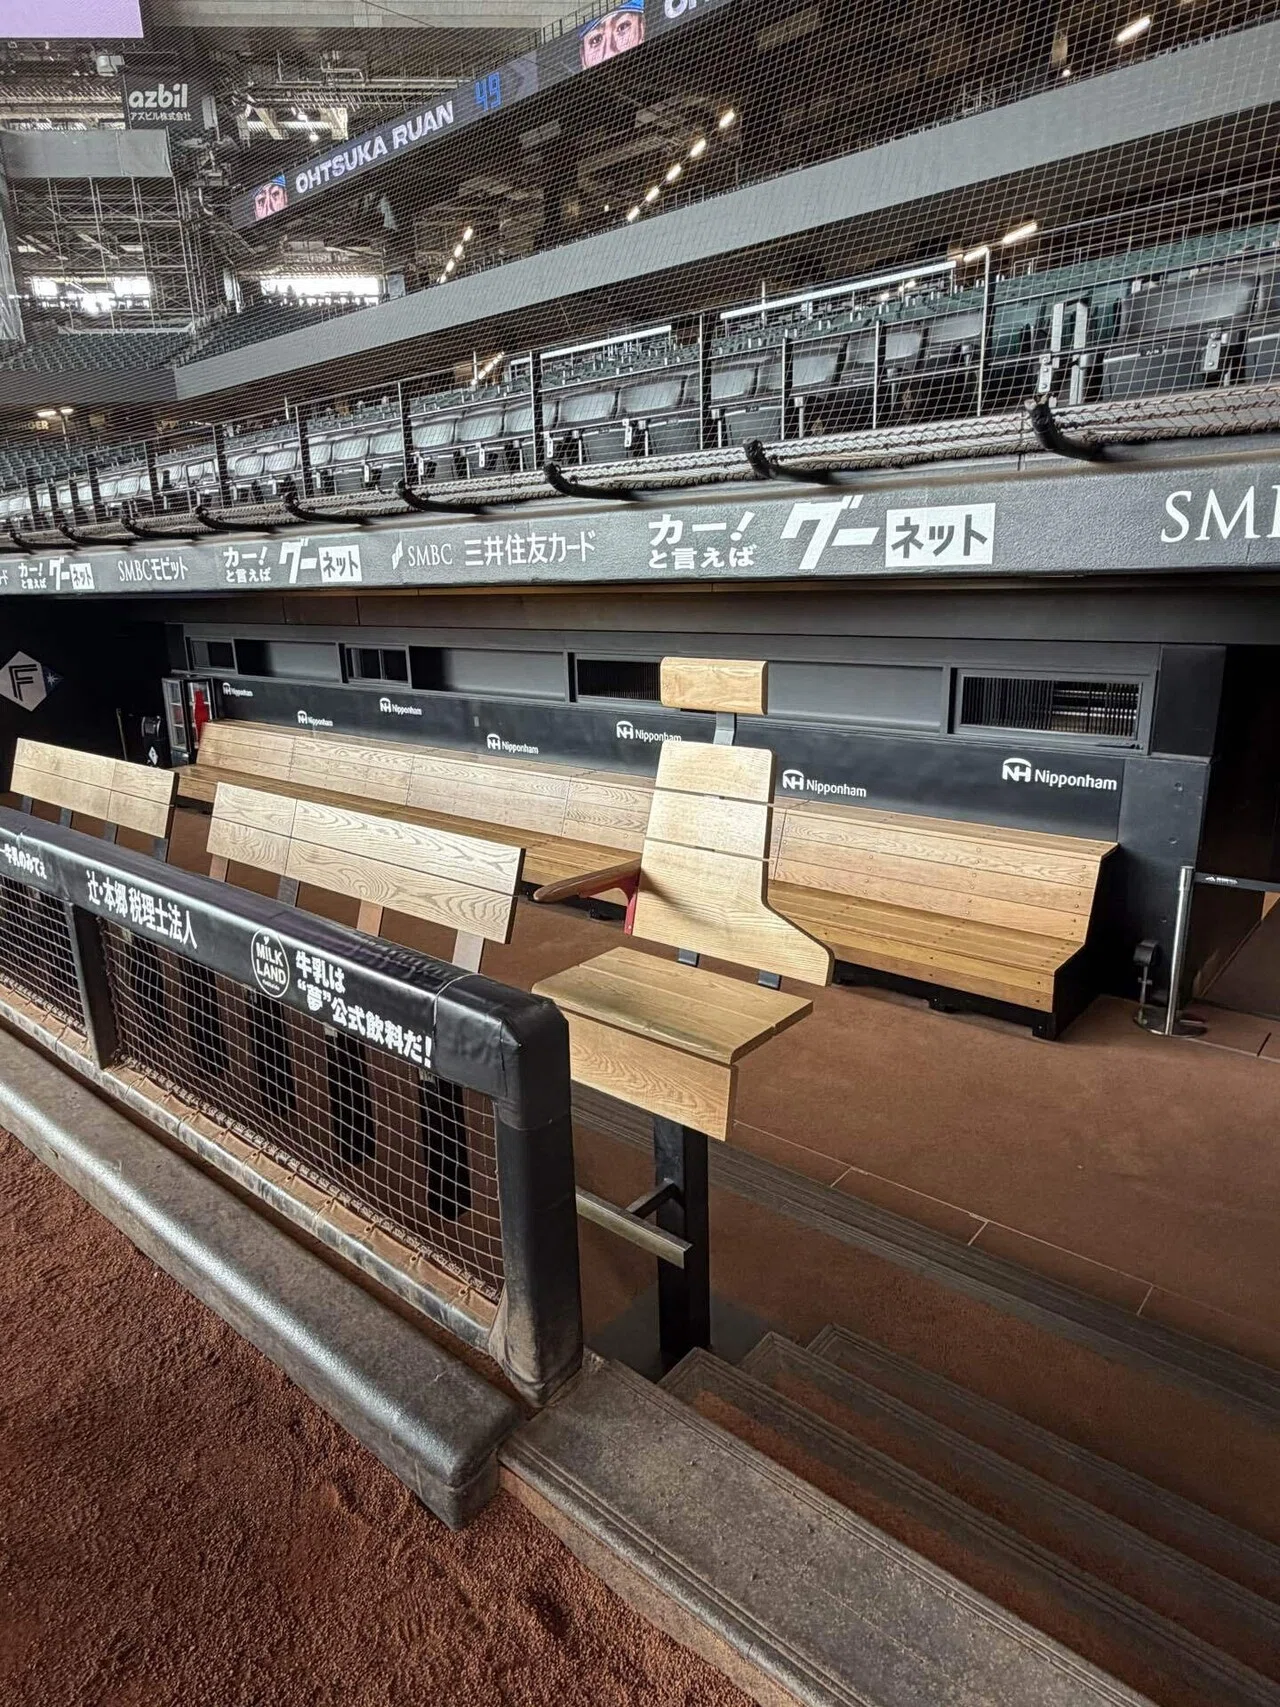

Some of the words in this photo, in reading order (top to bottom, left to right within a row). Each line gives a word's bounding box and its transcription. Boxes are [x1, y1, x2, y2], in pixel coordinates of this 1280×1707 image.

[129, 83, 188, 108] azbil
[130, 111, 193, 121] アズビル株式会社
[295, 136, 389, 194] OHTSUKA
[391, 101, 455, 149] RUAN
[475, 72, 502, 113] 49
[408, 543, 453, 568] SMBC
[464, 529, 597, 567] 三井住友カード
[648, 544, 757, 570] と言えば
[225, 567, 272, 584] と言えば
[392, 704, 422, 716] Nipponham
[501, 741, 539, 754] Nipponham
[635, 728, 682, 743] Nipponham
[806, 778, 867, 798] Nipponham
[1034, 768, 1117, 791] Nipponham
[256, 942, 285, 968] MILK
[256, 958, 287, 985] LAND
[296, 950, 346, 994] 牛乳は
